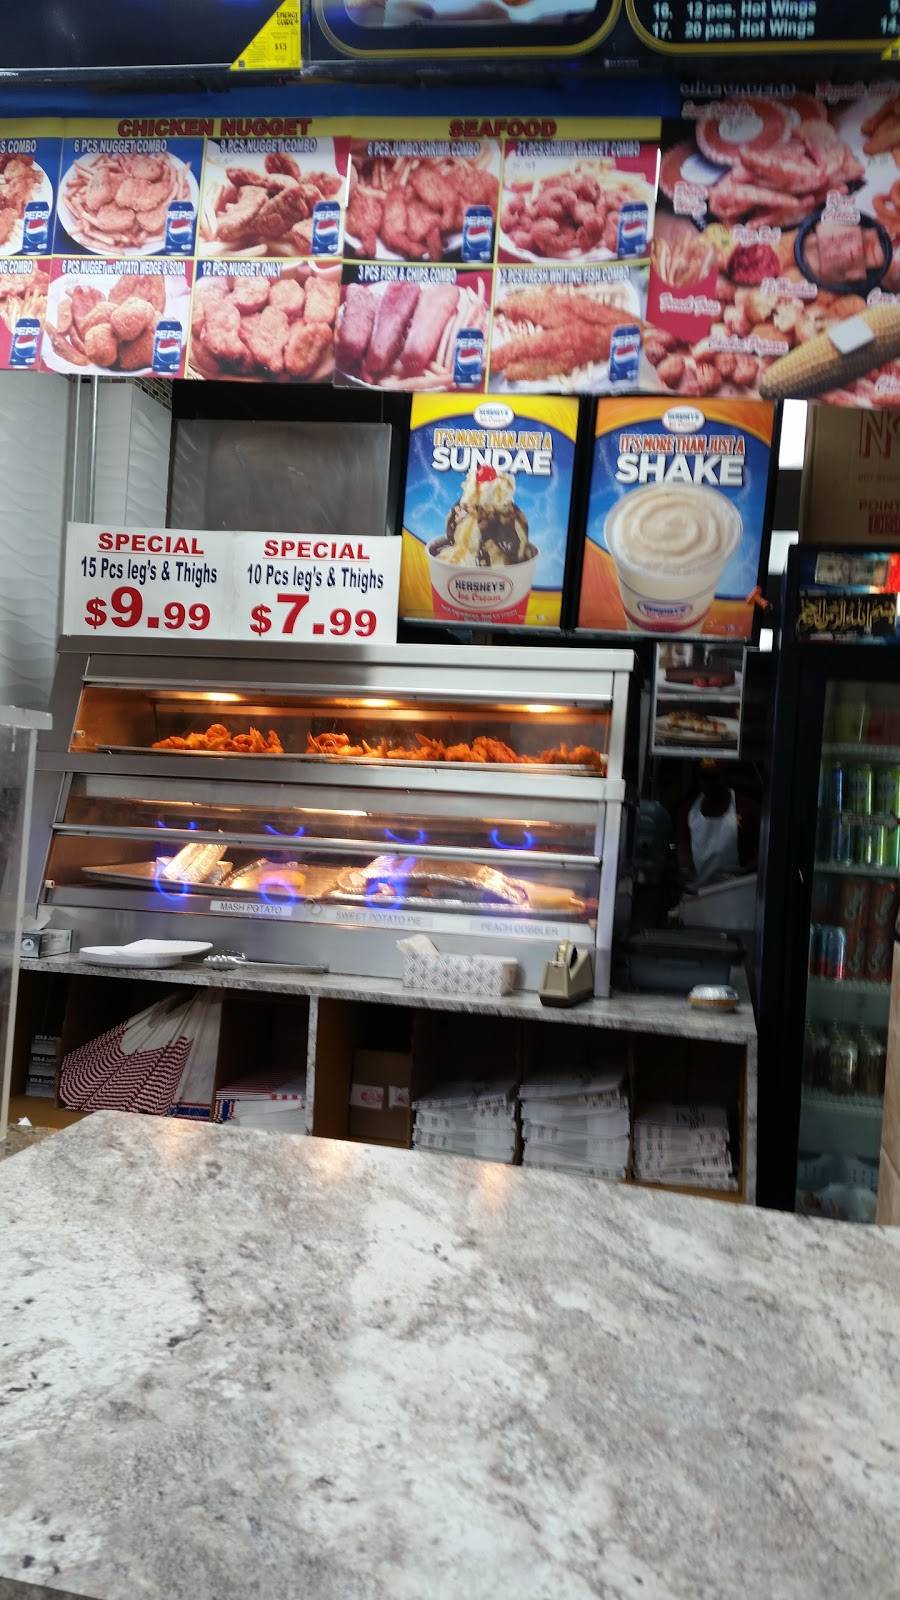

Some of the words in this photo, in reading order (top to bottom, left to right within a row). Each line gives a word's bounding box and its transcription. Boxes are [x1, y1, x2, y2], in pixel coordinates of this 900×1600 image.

[741, 0, 766, 18] Hot
[770, 0, 816, 20] Wings
[652, 22, 672, 39] 17.
[685, 21, 702, 39] 20
[740, 20, 765, 38] Hot
[770, 19, 815, 40] Wings
[118, 119, 214, 137] CHICKEN
[220, 118, 312, 136] NUGGET
[449, 118, 557, 138] SEAFOOD
[8, 139, 37, 153] COMBO
[74, 139, 79, 153] 6
[81, 139, 98, 153] PCS
[100, 139, 135, 153] NUGGET
[137, 139, 167, 153] COMBO
[228, 139, 245, 153] PCS
[246, 139, 284, 153] NUGGET
[285, 138, 317, 153] COMBO
[451, 142, 480, 157] COMBO
[611, 141, 640, 156] COMBO
[9, 260, 33, 273] COMBO
[68, 260, 80, 274] PCS
[80, 260, 106, 274] NUGGET
[115, 260, 139, 275] POTATO
[140, 260, 162, 275] WEDGE
[169, 261, 186, 275] SODA
[202, 261, 212, 276] 12
[212, 262, 228, 276] PCS
[228, 262, 260, 277] NUGGET
[261, 262, 283, 277] ONLY
[358, 265, 364, 280] 3
[365, 265, 379, 280] PCS
[380, 265, 398, 281] FISH
[406, 266, 429, 283] CHIPS
[430, 267, 457, 284] COMBO
[433, 428, 455, 447] IT'S
[455, 429, 486, 447] MORE
[486, 430, 517, 449] THAN
[517, 431, 543, 450] JUST
[542, 431, 552, 450] A
[619, 434, 641, 454] IT'S
[641, 434, 675, 454] MORE
[674, 434, 707, 455] THAN
[708, 435, 736, 456] JUST
[734, 435, 745, 456] A
[431, 446, 553, 476] SUNDAE
[614, 453, 745, 486] SHAKE
[98, 533, 204, 555] SPECIAL
[264, 539, 370, 560] SPECIAL
[81, 556, 96, 578] 15
[101, 558, 123, 580] Pcs
[128, 559, 157, 585] leg's
[161, 561, 170, 581] &
[176, 562, 217, 588] Thighs
[247, 563, 262, 584] 10
[266, 565, 289, 586] Pcs
[293, 566, 322, 592] leg's
[327, 567, 336, 587] &
[342, 567, 384, 593] Thighs
[455, 579, 506, 593] HERSHEY'S
[84, 585, 211, 631] $9.99
[249, 592, 377, 637] $7.99
[220, 902, 245, 912] MASH
[247, 904, 283, 914] POTATO
[335, 911, 367, 921] SWEET
[369, 912, 406, 923] POTATO
